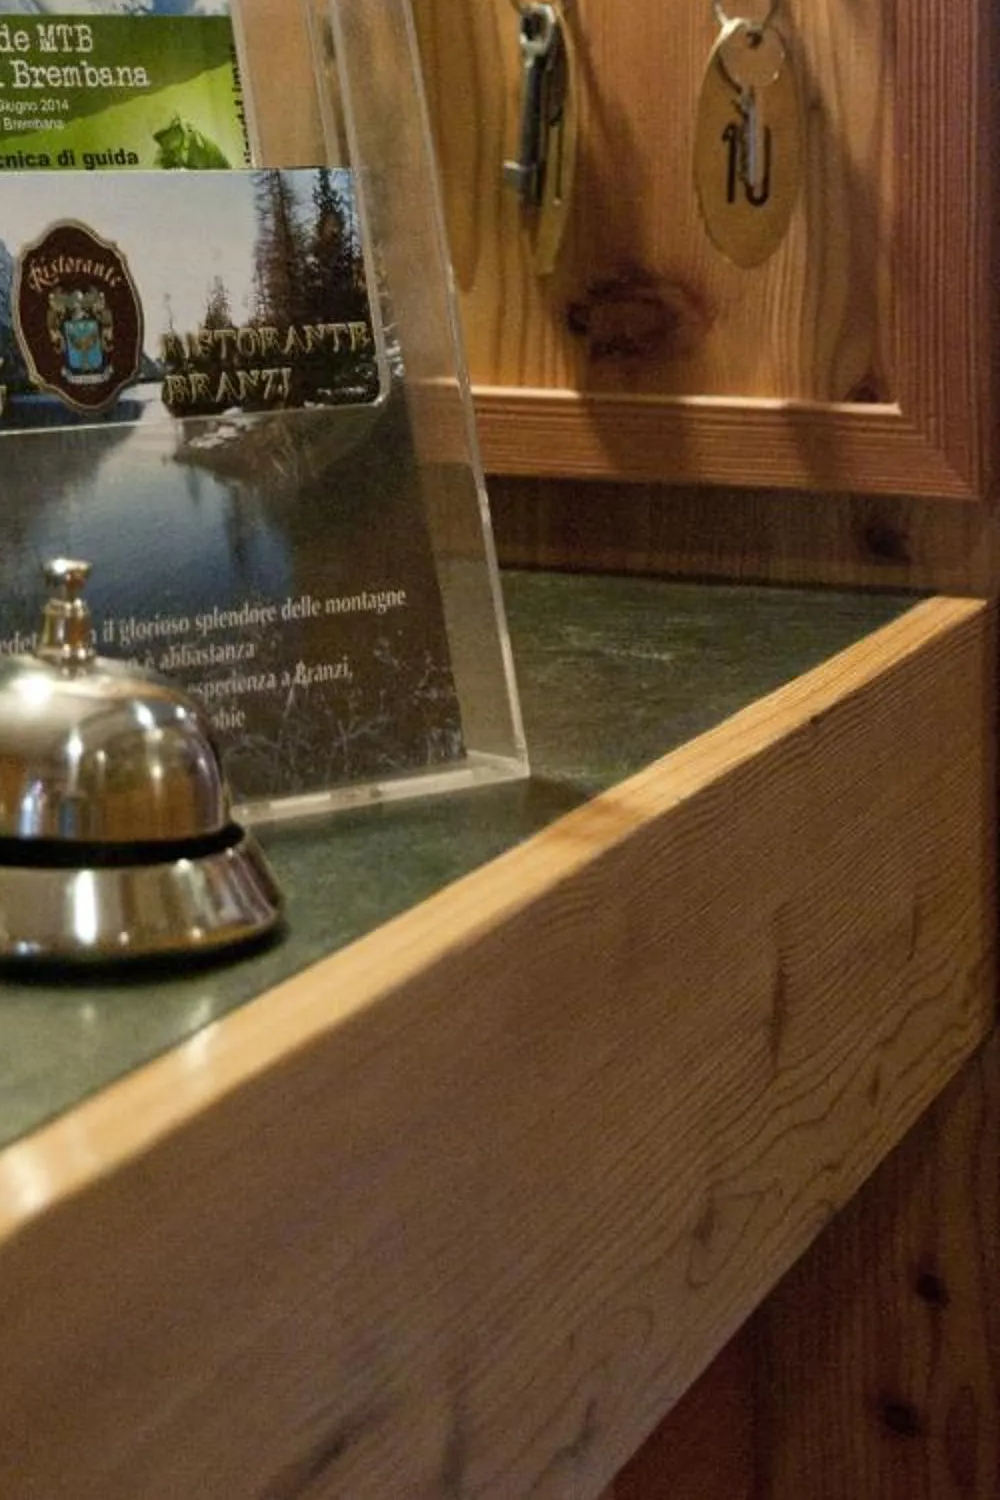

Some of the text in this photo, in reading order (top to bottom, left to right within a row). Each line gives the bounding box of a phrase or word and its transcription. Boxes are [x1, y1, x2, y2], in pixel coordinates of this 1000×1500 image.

[35, 23, 94, 53] MTB
[9, 59, 151, 88] Brembana
[40, 99, 69, 112] 2014
[4, 117, 65, 131] Brembana
[57, 149, 76, 167] di
[83, 148, 140, 171] guida
[28, 255, 122, 293] Ristorante
[160, 320, 372, 363] RISTORANTE
[103, 618, 115, 643] il
[119, 611, 191, 647] glorioso
[194, 604, 278, 637] splendore
[281, 595, 322, 621] delle
[325, 588, 407, 615] montagne
[159, 642, 256, 671] abbastanza
[281, 671, 292, 689] a
[294, 654, 354, 687] Branzi,
